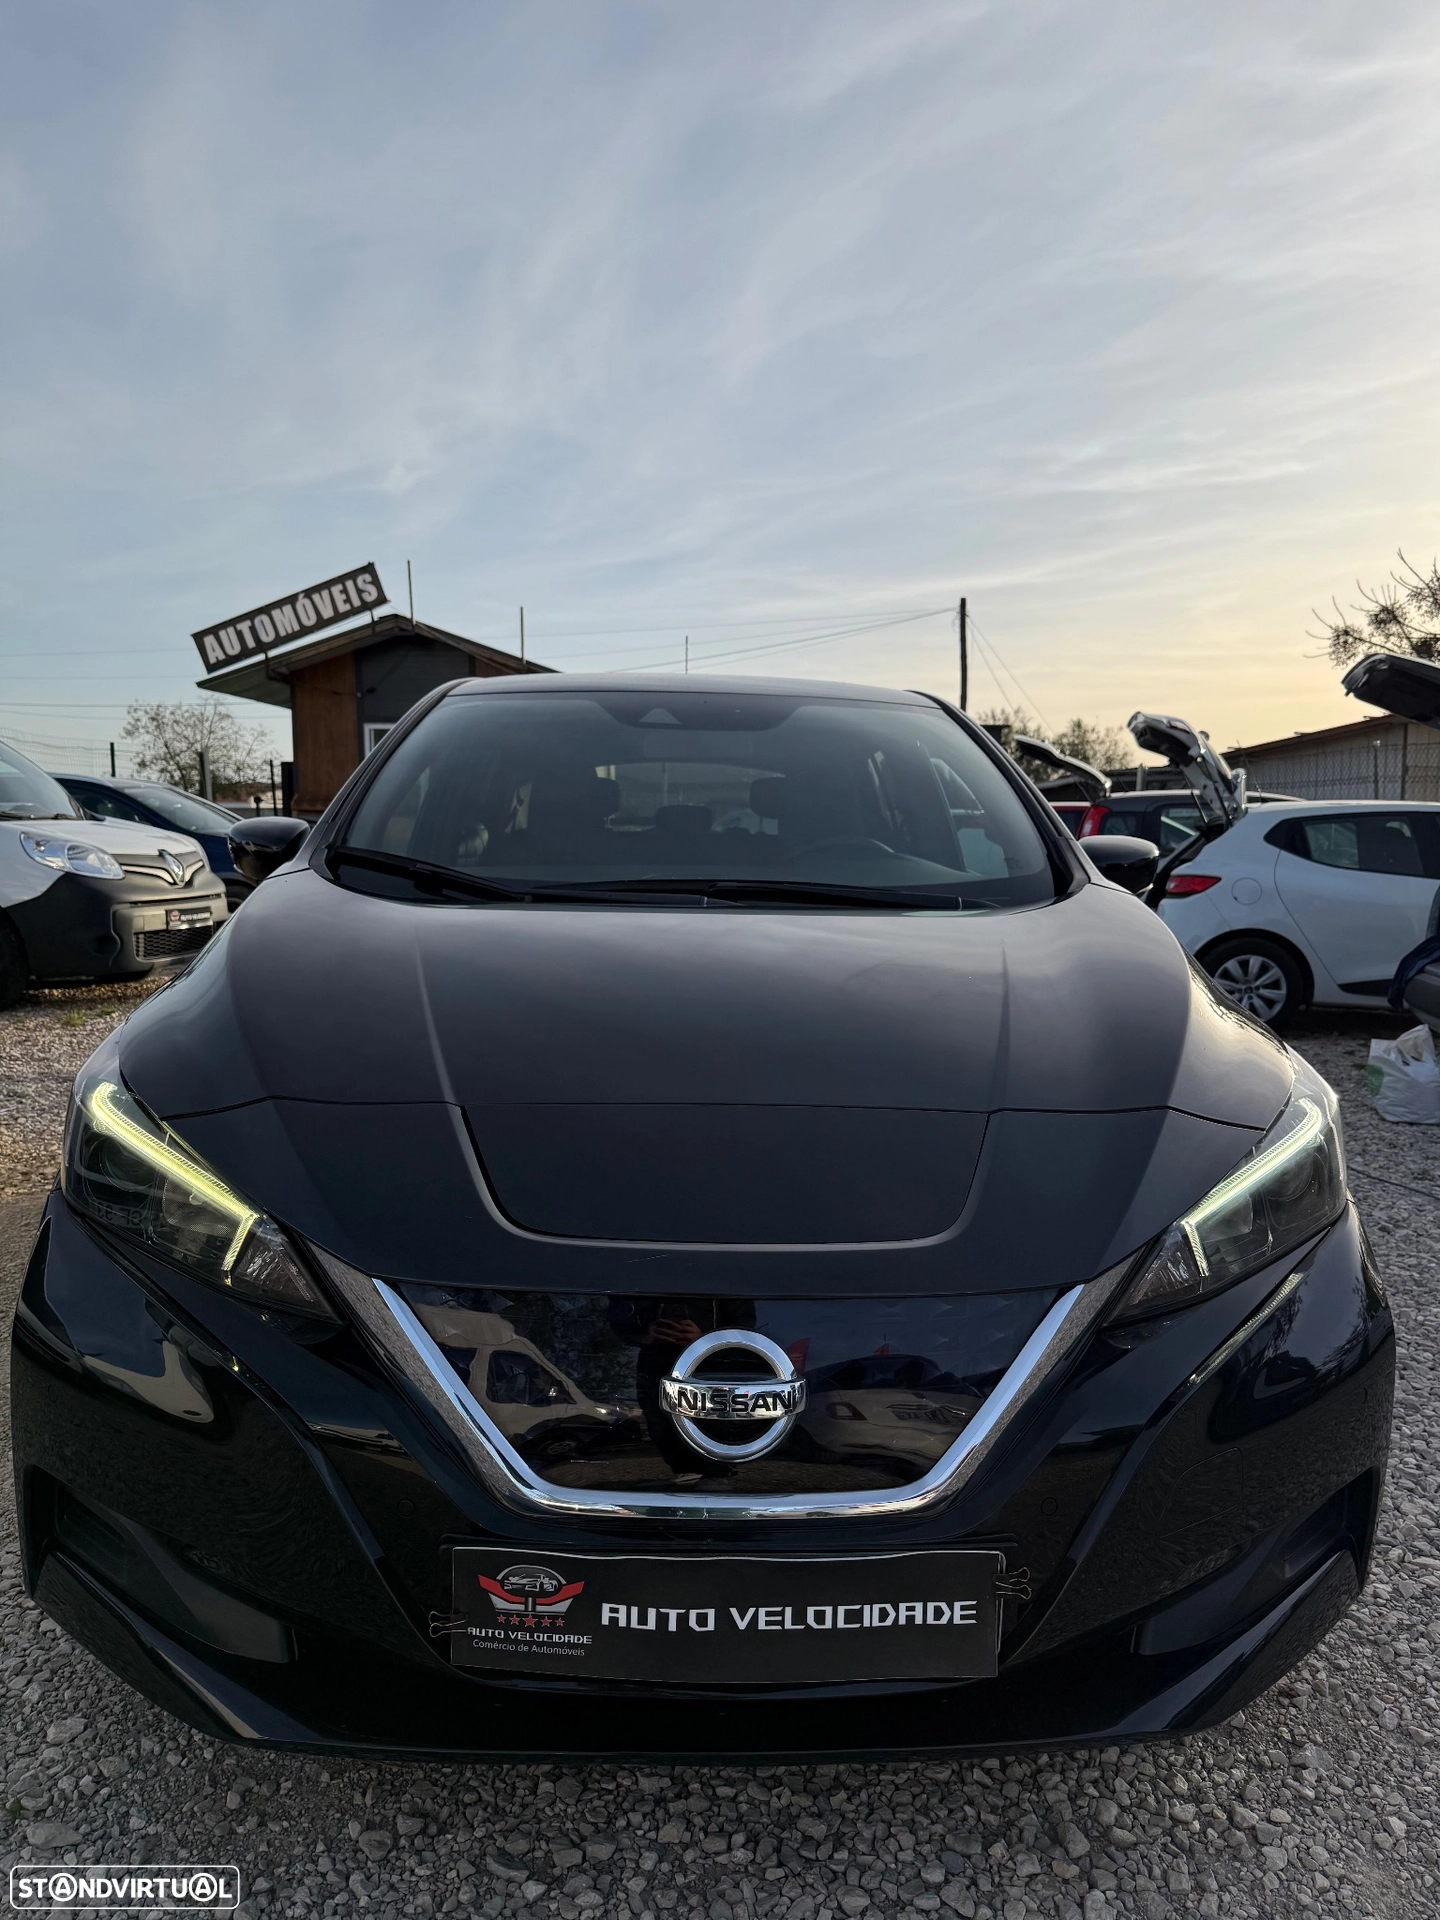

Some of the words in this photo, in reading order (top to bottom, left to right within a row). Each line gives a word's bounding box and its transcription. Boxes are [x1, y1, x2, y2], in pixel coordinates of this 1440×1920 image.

[203, 572, 379, 665] AUTOMÓVEIS
[677, 1388, 792, 1413] NISSAN
[601, 1602, 716, 1632] AUTO
[729, 1600, 978, 1630] VELOCIDADE
[467, 1626, 505, 1639] AUTO
[508, 1631, 593, 1645] VELOCIDADE
[472, 1639, 516, 1651] Comércio
[517, 1643, 529, 1652] de
[531, 1644, 585, 1656] Automóveis
